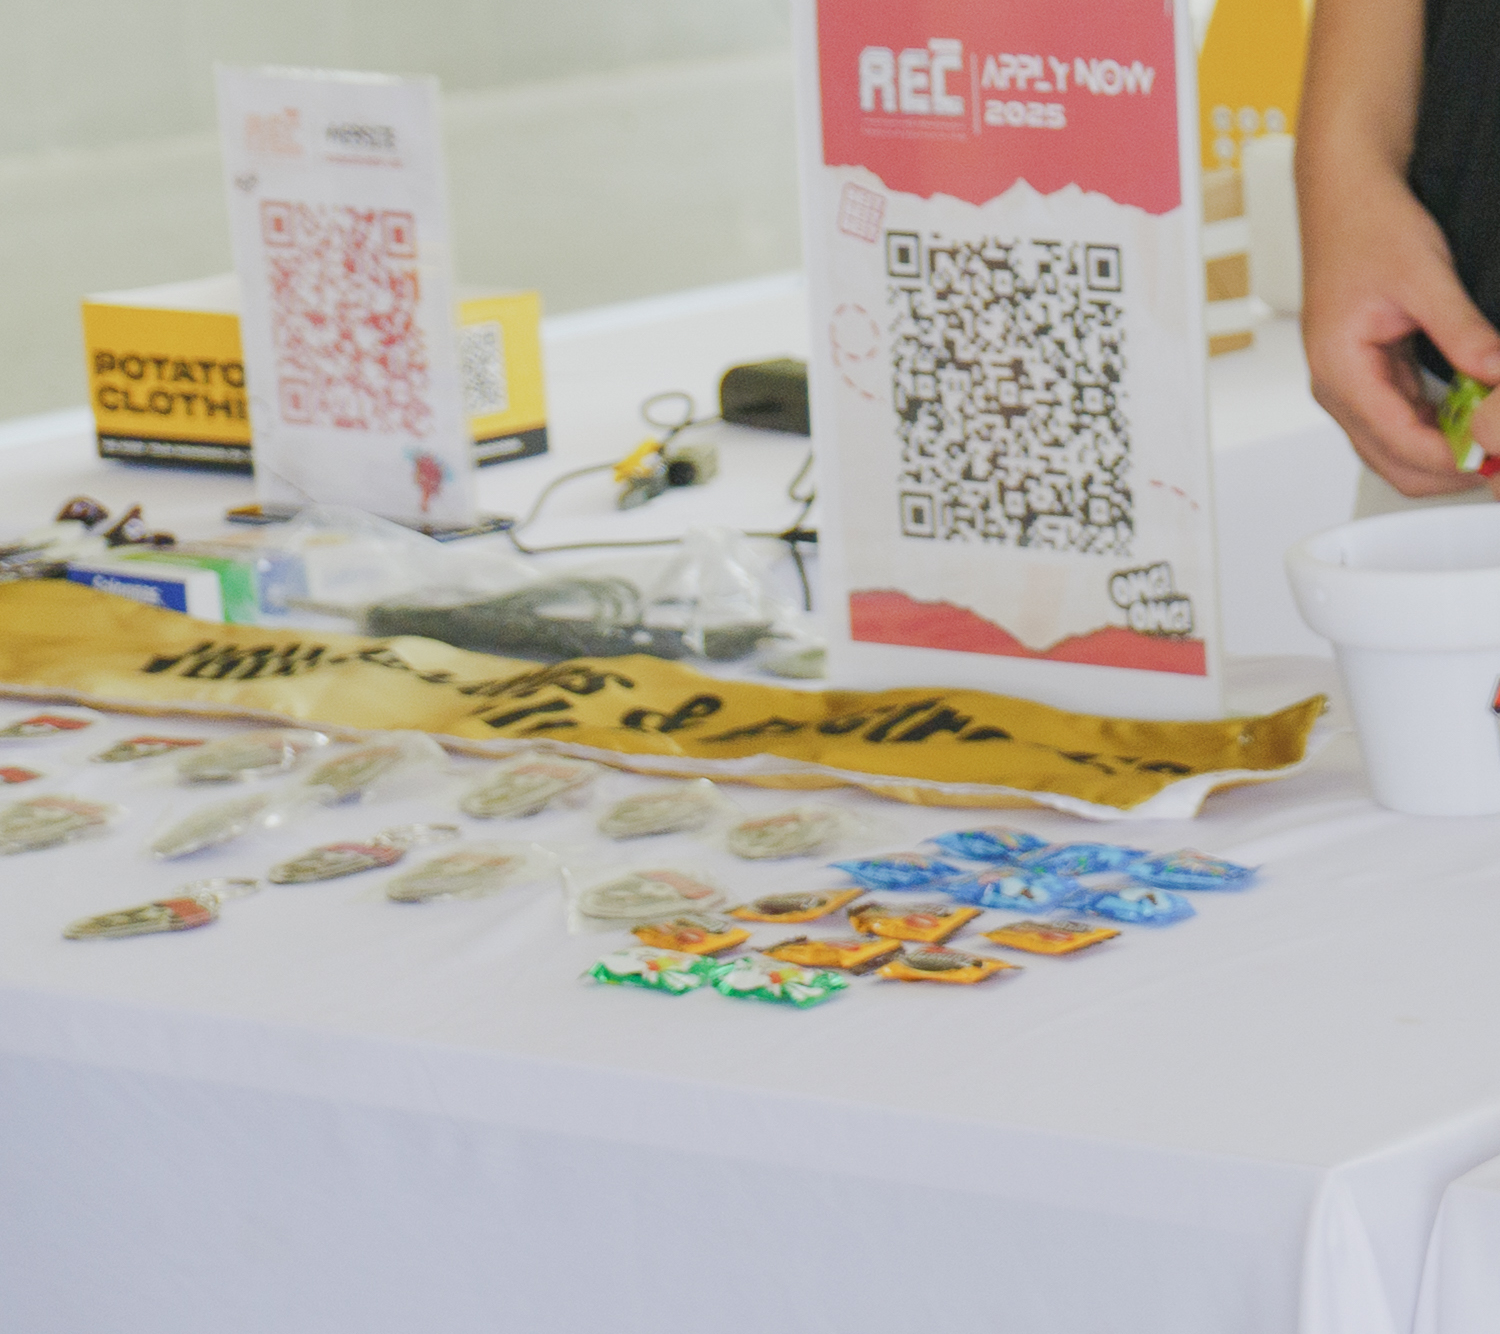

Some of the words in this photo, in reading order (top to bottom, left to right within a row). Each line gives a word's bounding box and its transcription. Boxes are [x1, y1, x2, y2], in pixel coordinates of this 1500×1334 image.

[859, 39, 965, 116] REC
[981, 53, 1070, 93] APPLY
[1073, 57, 1155, 96] NOW
[984, 99, 1067, 129] 2025
[95, 350, 245, 388] POTATO
